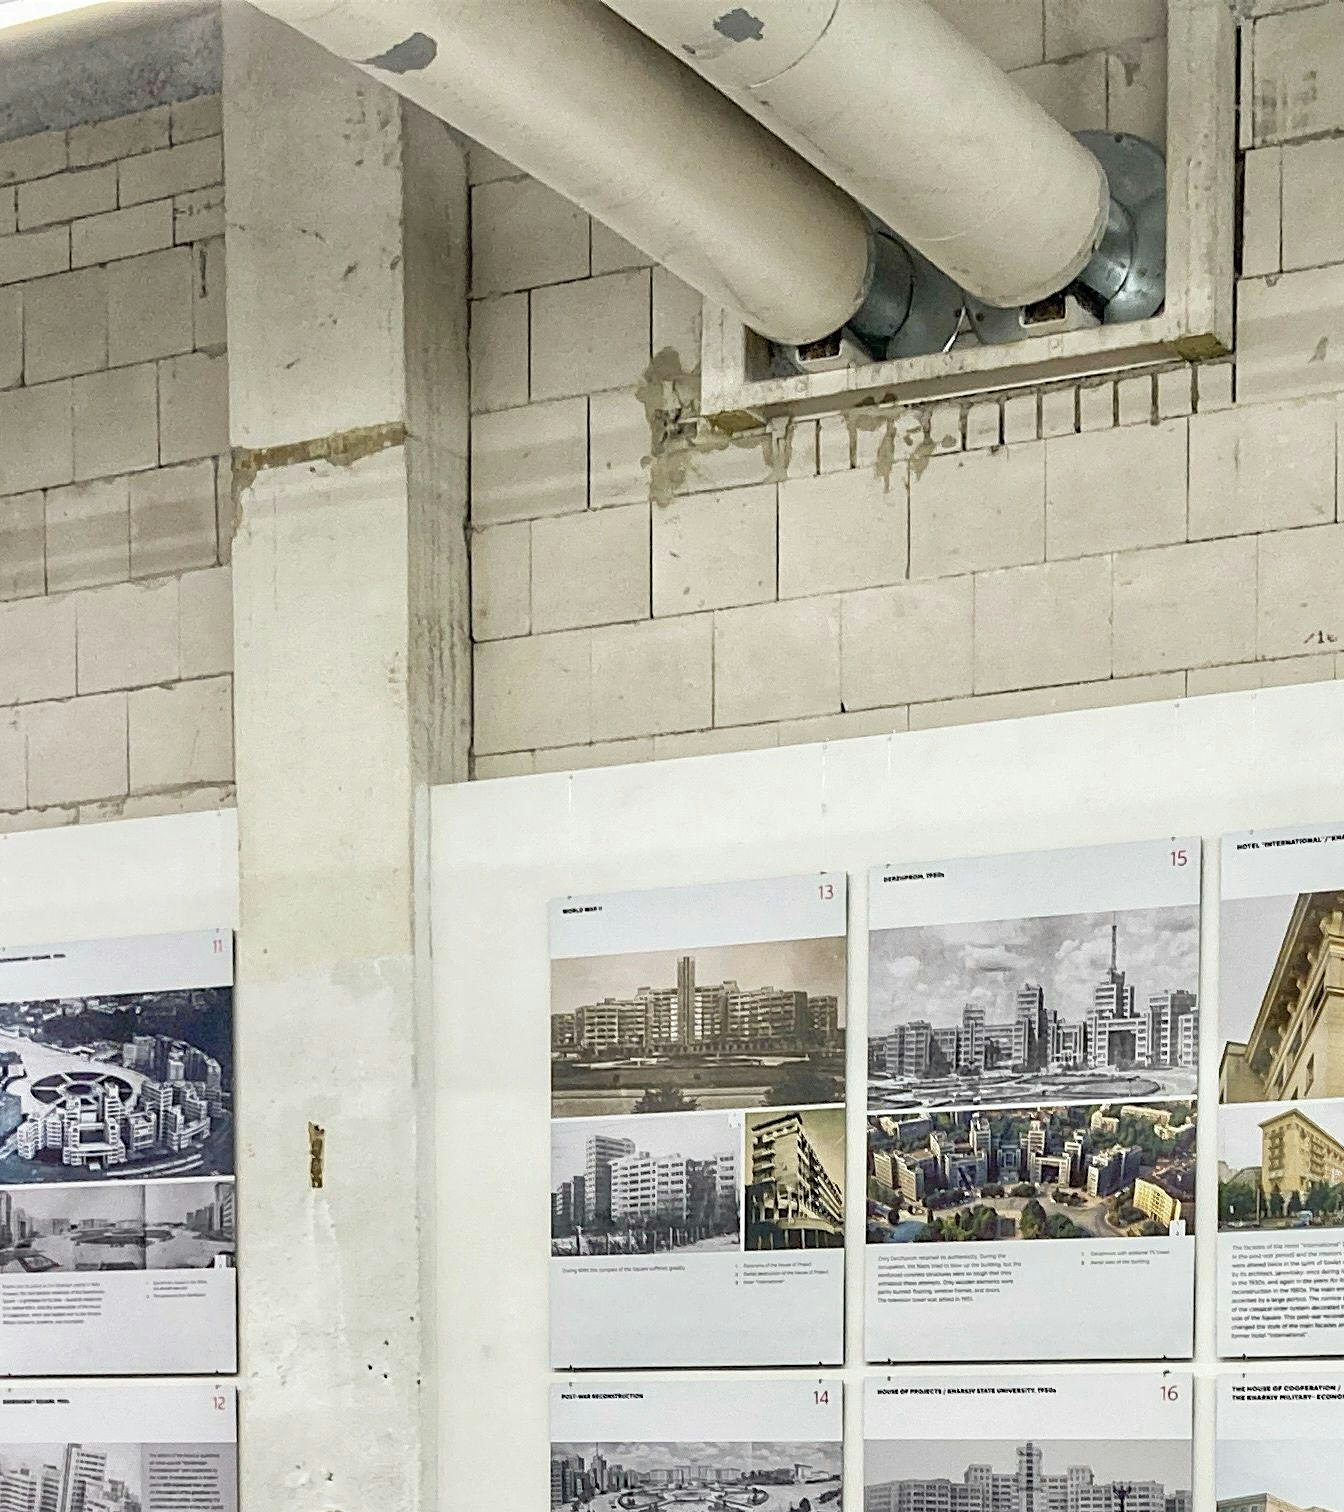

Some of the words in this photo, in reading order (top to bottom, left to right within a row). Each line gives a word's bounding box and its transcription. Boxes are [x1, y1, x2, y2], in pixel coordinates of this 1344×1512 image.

[1170, 849, 1187, 866] 15
[818, 884, 834, 900] 13
[212, 939, 222, 953] 11
[813, 1390, 829, 1405] 14
[1160, 1385, 1178, 1401] 16
[212, 1396, 226, 1410] 12
